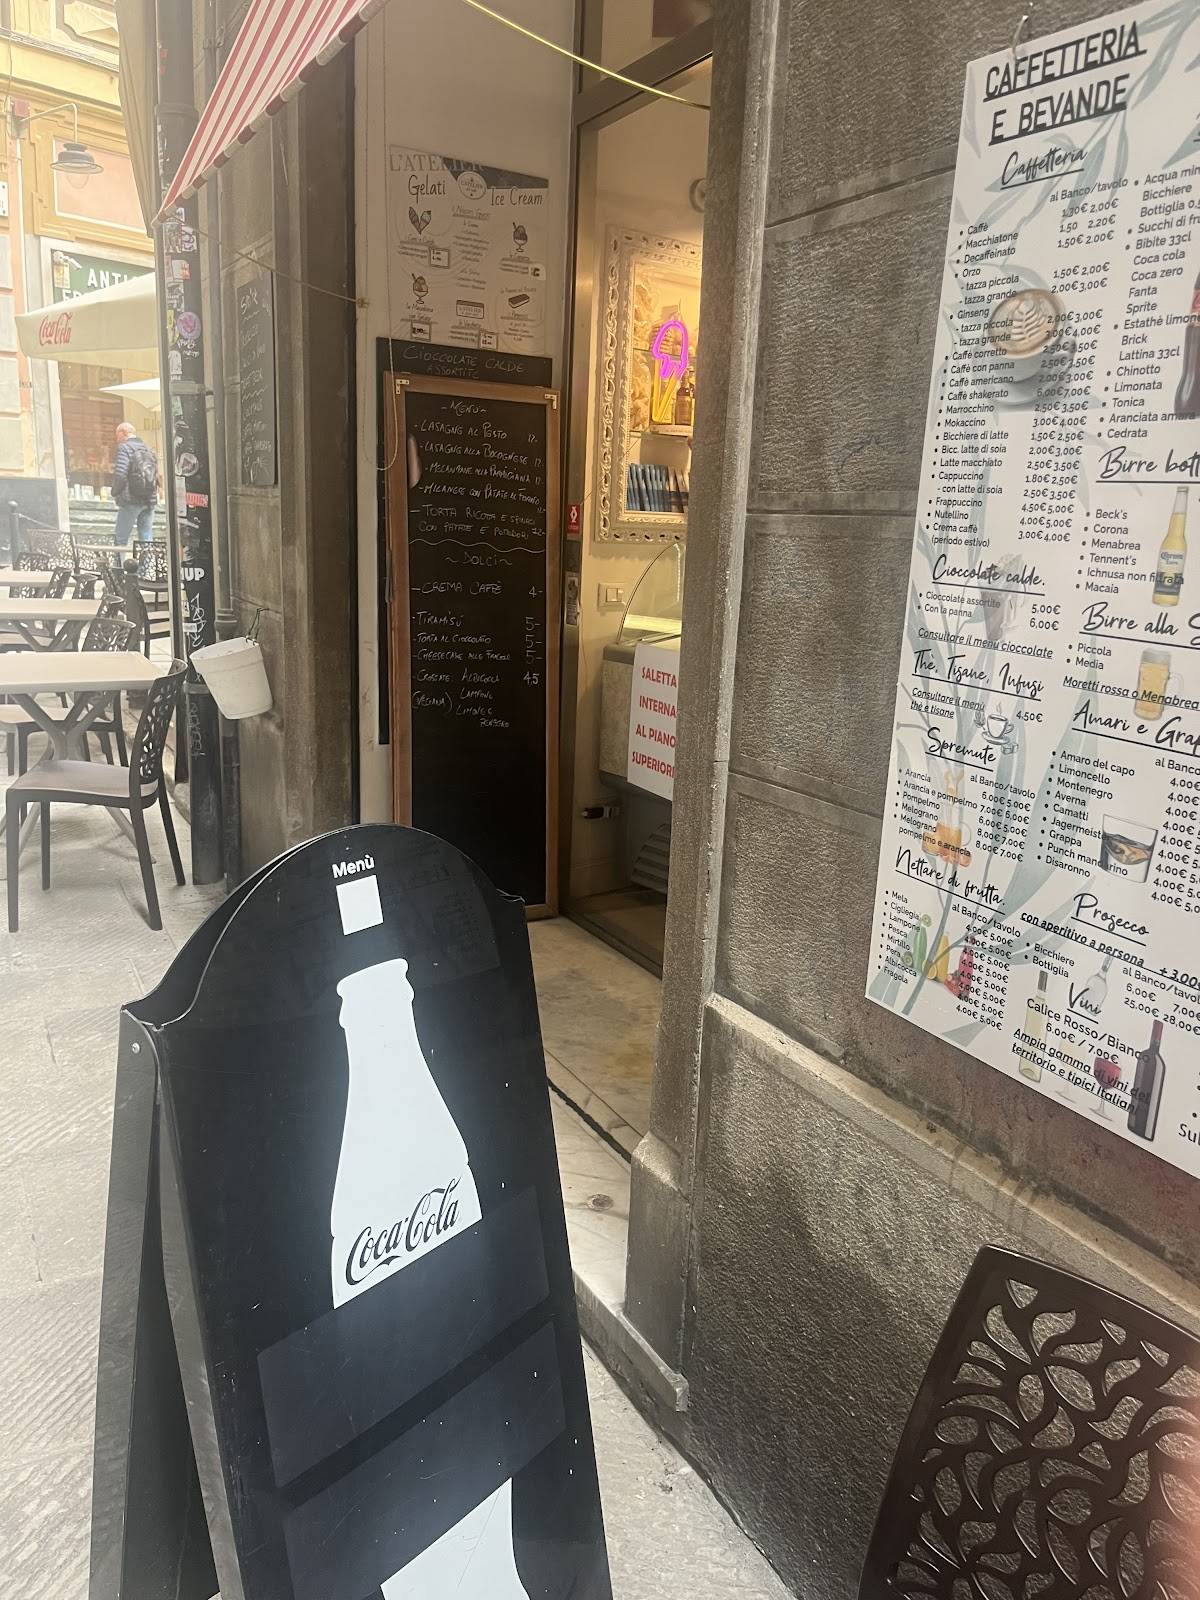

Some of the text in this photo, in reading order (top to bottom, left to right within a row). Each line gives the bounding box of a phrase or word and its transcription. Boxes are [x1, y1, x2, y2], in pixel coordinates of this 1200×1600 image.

[985, 21, 1140, 99] CAFFETTERIA
[991, 74, 1130, 144] E BEVANDE
[1001, 147, 1088, 186] Caffetteria
[1144, 171, 1178, 185] Acqua
[408, 174, 446, 204] Gelati
[490, 186, 544, 207] Ice Cream
[1061, 178, 1128, 200] Banco/tavolo
[1142, 184, 1193, 201] Bicchiere
[1140, 202, 1185, 217] Bottiglia
[1137, 218, 1173, 234] Succhi
[965, 231, 1019, 250] Macchiatone
[1136, 231, 1191, 250] Bibite 33cl
[963, 246, 1016, 264] Decaffeinato
[1133, 249, 1186, 266] Coca cola
[962, 268, 981, 278] Orzo
[1131, 267, 1183, 282] Coca zero
[988, 274, 1020, 289] piccola
[986, 289, 1017, 304] grande
[1128, 286, 1158, 298] Fanta
[957, 308, 990, 320] Ginseng
[1126, 300, 1158, 316] Sprite
[960, 318, 1014, 332] tazza piccola
[959, 333, 1012, 347] tazza grande
[1121, 334, 1148, 346] Brick
[973, 349, 1007, 359] corretto
[1119, 346, 1180, 361] Lattina 33cl
[988, 361, 1015, 372] panna
[1116, 364, 1161, 377] Chinotto
[970, 375, 1014, 386] americano
[1114, 380, 1163, 393] Limonata
[968, 388, 1009, 400] shakerato
[946, 404, 995, 415] Marrocchino
[1112, 397, 1145, 408] Tonica
[944, 418, 986, 428] Mokaccino
[1109, 411, 1158, 423] Aranciata
[943, 430, 1009, 441] Bicchiere latte
[1107, 427, 1148, 439] Cedrata
[990, 445, 1007, 454] soia
[940, 458, 1003, 468] Latte macchiato
[1098, 445, 1158, 479] Birre
[938, 471, 984, 483] Cappuccino
[957, 485, 976, 494] latte
[935, 497, 983, 509] Frappuccino
[934, 510, 969, 520] Nutellino
[1095, 508, 1128, 520] Beck's
[933, 523, 957, 533] Crema
[1093, 523, 1129, 535] Corona
[932, 536, 990, 548] (periodo estivo)
[1091, 538, 1141, 551] Menabrea
[1089, 552, 1137, 566] Tennent's
[931, 553, 1001, 585] Cioccolate
[1087, 568, 1147, 582] Ichnusa non
[421, 581, 464, 594] CREMA
[1084, 581, 1119, 594] Macaia
[926, 591, 966, 604] Cioccolate
[924, 603, 972, 618] Con panna
[1081, 601, 1179, 636] Birre alla
[917, 628, 1054, 659] Consultare cioccolate
[1077, 642, 1112, 657] Piccola
[1075, 657, 1104, 670] Media
[641, 666, 678, 689] SALETTA
[999, 662, 1045, 698] Infusi
[912, 687, 954, 705] Consultare
[1063, 675, 1200, 709] Moretti rossa Menabrea
[639, 695, 677, 718] INTERNA
[930, 704, 955, 718] tisane
[1072, 699, 1148, 734] Amari e
[635, 724, 676, 749] AL PIANO
[927, 726, 997, 765] Spremute
[1060, 750, 1135, 776] Amaro del capo
[905, 768, 931, 783] Arancia
[1058, 763, 1111, 785] Limoncello
[904, 780, 978, 810] Arancia pompelmo
[1056, 777, 1113, 800] Montenegro
[902, 791, 941, 810] Pompelmo
[1054, 790, 1087, 807] Averna
[901, 803, 939, 822] Melograno
[1053, 803, 1089, 821] Camatti
[900, 814, 937, 833] Melograno
[1049, 829, 1082, 848] Grappa
[1047, 842, 1075, 858] Punch
[331, 854, 375, 879] Menù
[895, 846, 961, 889] Nettare di
[1045, 855, 1091, 878] Disaronno
[892, 890, 908, 904] Mela
[1073, 892, 1150, 936] Prosecco
[889, 913, 921, 932] Lampone
[888, 924, 908, 938] Pesca
[887, 934, 911, 951] Mirtillo
[1020, 911, 1145, 968] con aperitivo persona
[1034, 943, 1075, 967] Bicchiere
[885, 955, 917, 977] Albicocca
[1032, 955, 1069, 978] Bottiglia
[884, 966, 908, 984] Fragola
[1068, 982, 1102, 1016] Vini
[1027, 998, 1061, 1022] Calice
[1013, 1027, 1092, 1075] Ampia gamma
[1012, 1042, 1096, 1093] territorio tipici
[345, 1177, 462, 1286] Coca-Cola
